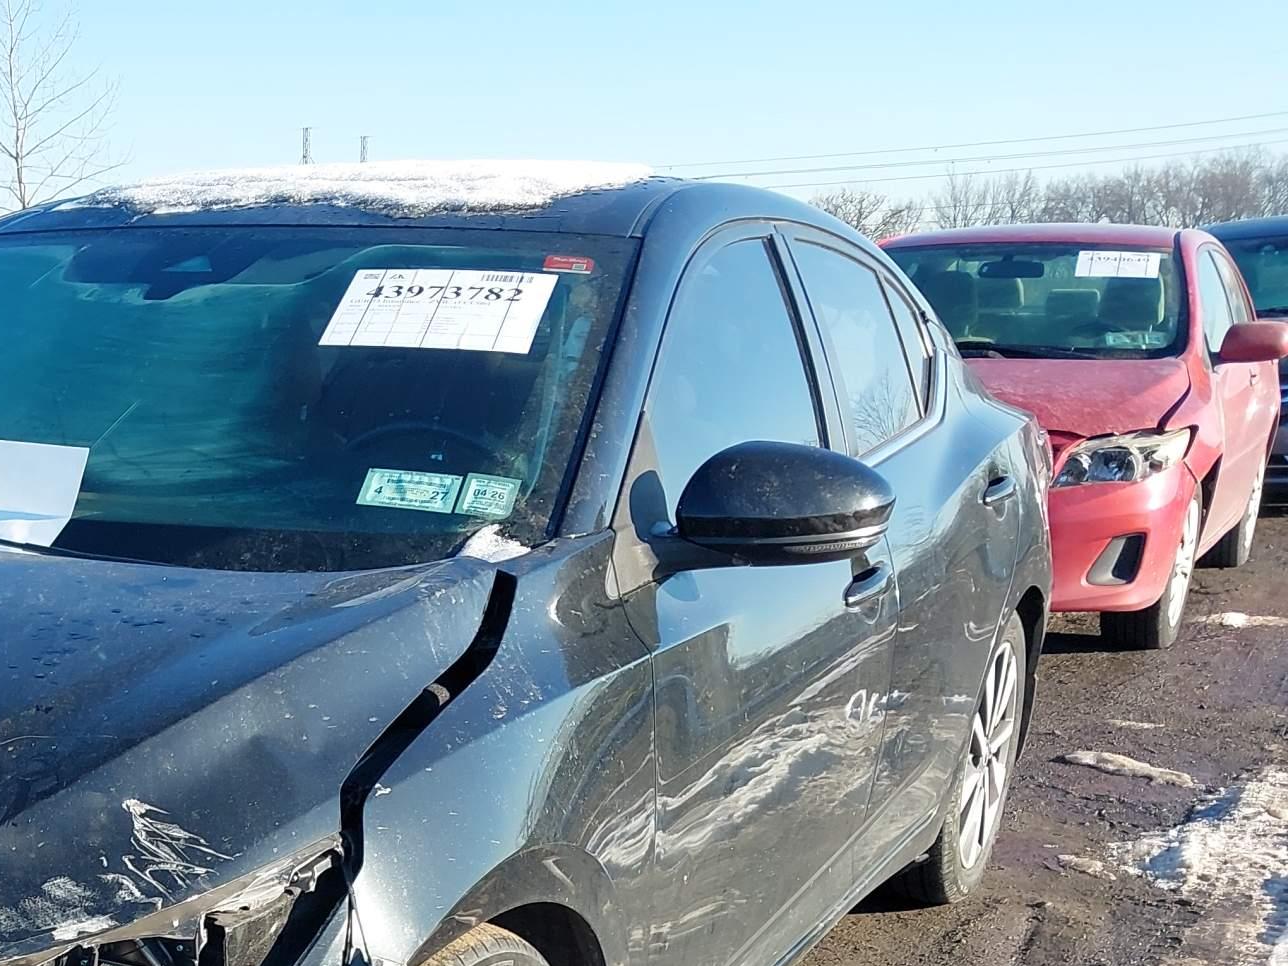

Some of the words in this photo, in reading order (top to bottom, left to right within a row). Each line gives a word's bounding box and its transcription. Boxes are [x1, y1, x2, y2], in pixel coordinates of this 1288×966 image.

[366, 285, 523, 302] 43973782
[374, 486, 383, 495] 4
[430, 490, 448, 501] 27
[473, 488, 487, 497] 04
[490, 490, 505, 500] 26
